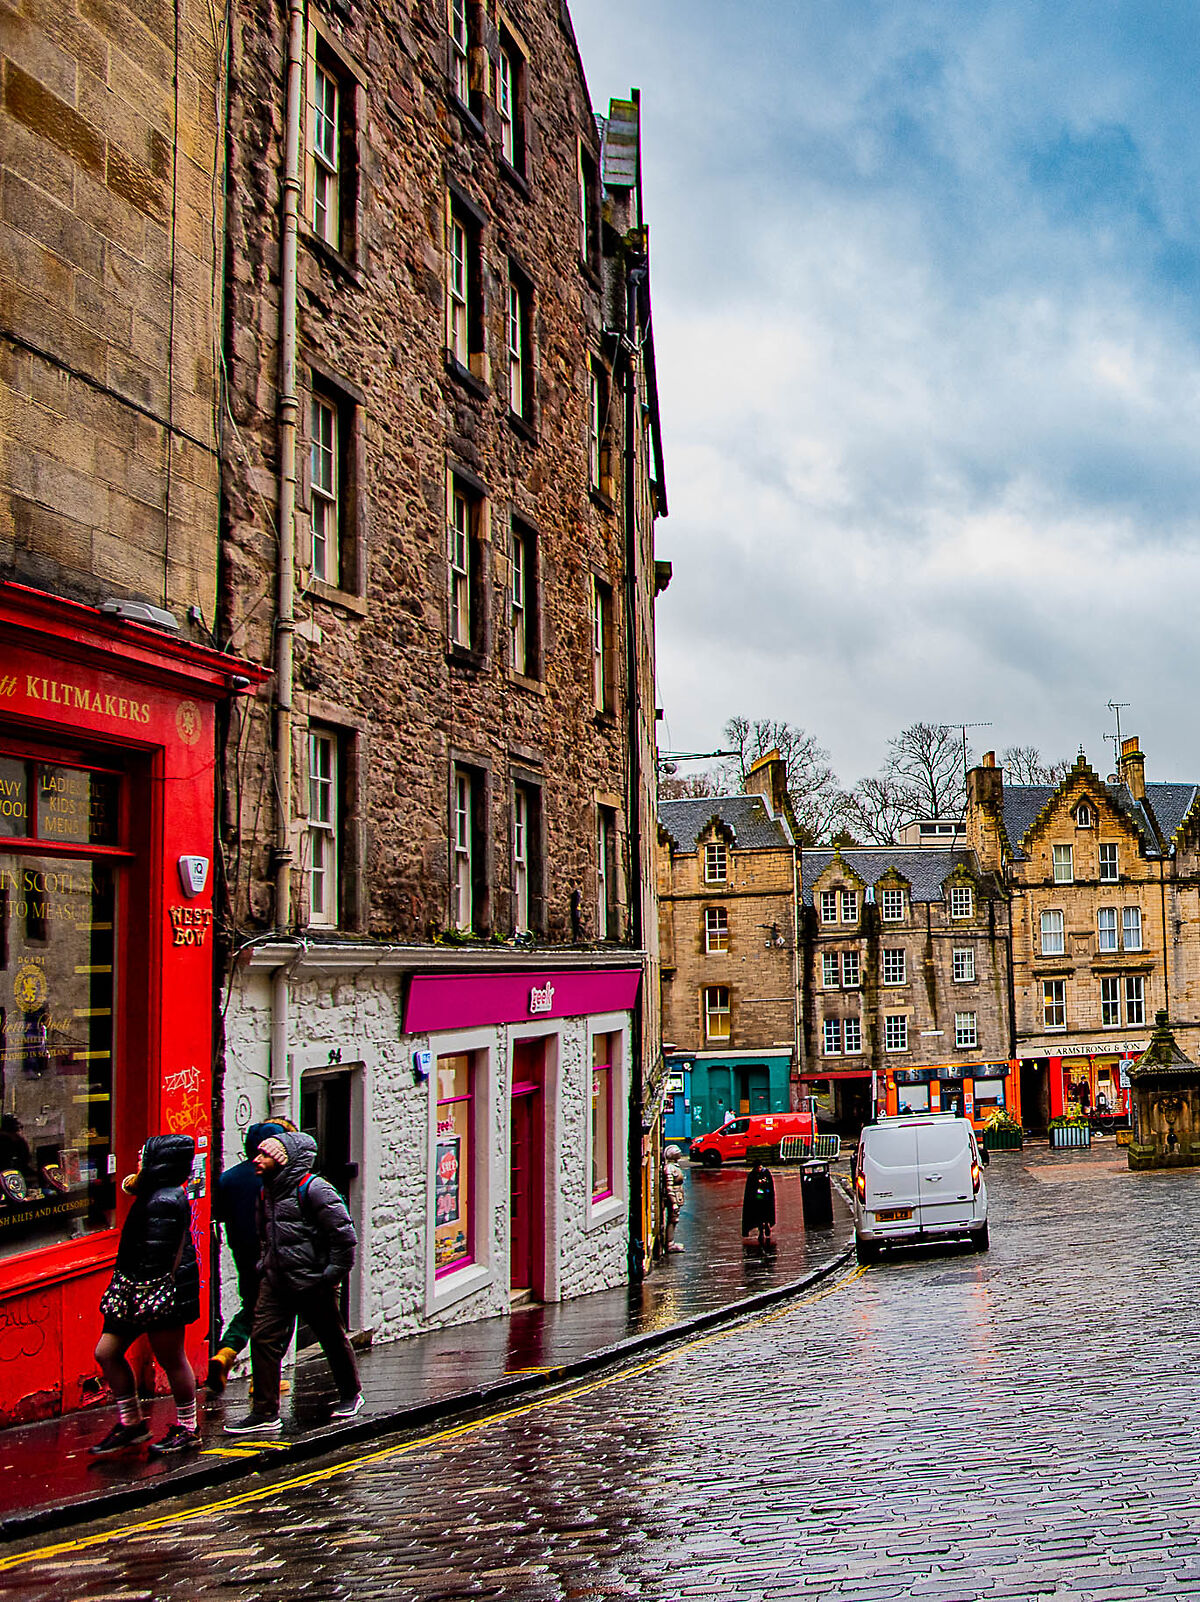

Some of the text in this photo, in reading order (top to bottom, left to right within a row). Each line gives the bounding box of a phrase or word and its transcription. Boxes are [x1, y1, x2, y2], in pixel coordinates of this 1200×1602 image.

[26, 675, 150, 724] KILTMAKERS
[50, 797, 77, 814] KIDS
[0, 869, 20, 890] IN
[6, 900, 28, 919] TO
[169, 905, 213, 926] WEST
[173, 927, 207, 946] BOW
[531, 981, 555, 1013] geek
[1043, 1042, 1141, 1056] W. ARMSTRONG & SON
[12, 1210, 33, 1224] KILTS
[35, 1207, 51, 1219] AND
